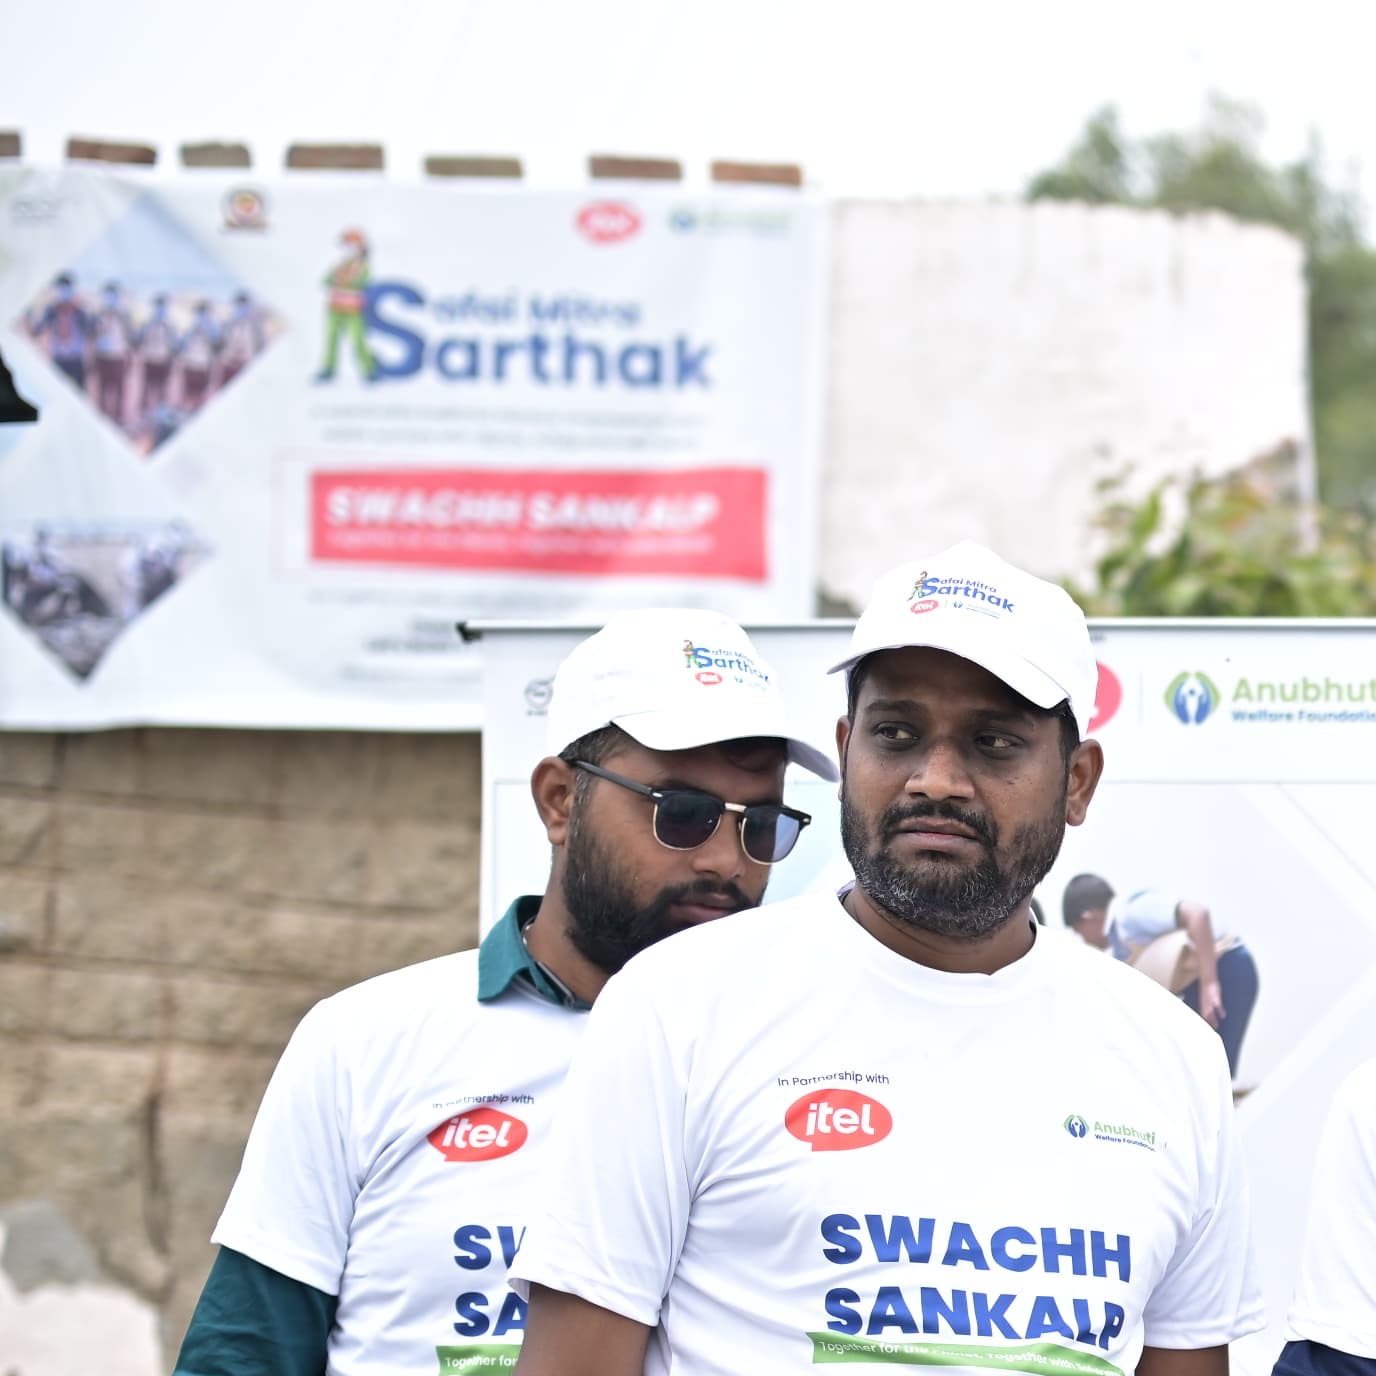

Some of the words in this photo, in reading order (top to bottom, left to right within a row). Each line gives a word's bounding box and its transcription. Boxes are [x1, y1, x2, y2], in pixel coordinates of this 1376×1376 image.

[364, 278, 713, 388] Sarthak
[921, 577, 1015, 613] Sarthak
[965, 579, 997, 593] Mitra
[1231, 709, 1294, 722] Welfare
[778, 1077, 789, 1087] In
[792, 1070, 863, 1086] Partnership
[865, 1073, 890, 1085] with
[511, 1094, 535, 1105] with
[805, 1101, 875, 1136] itel
[441, 1117, 512, 1149] itel
[1094, 1121, 1156, 1145] Anubhuti
[820, 1213, 1131, 1283] SWACHH
[824, 1285, 1125, 1351] SANKALP
[819, 1341, 877, 1355] Together
[878, 1342, 900, 1354] for
[445, 1354, 495, 1370] Together
